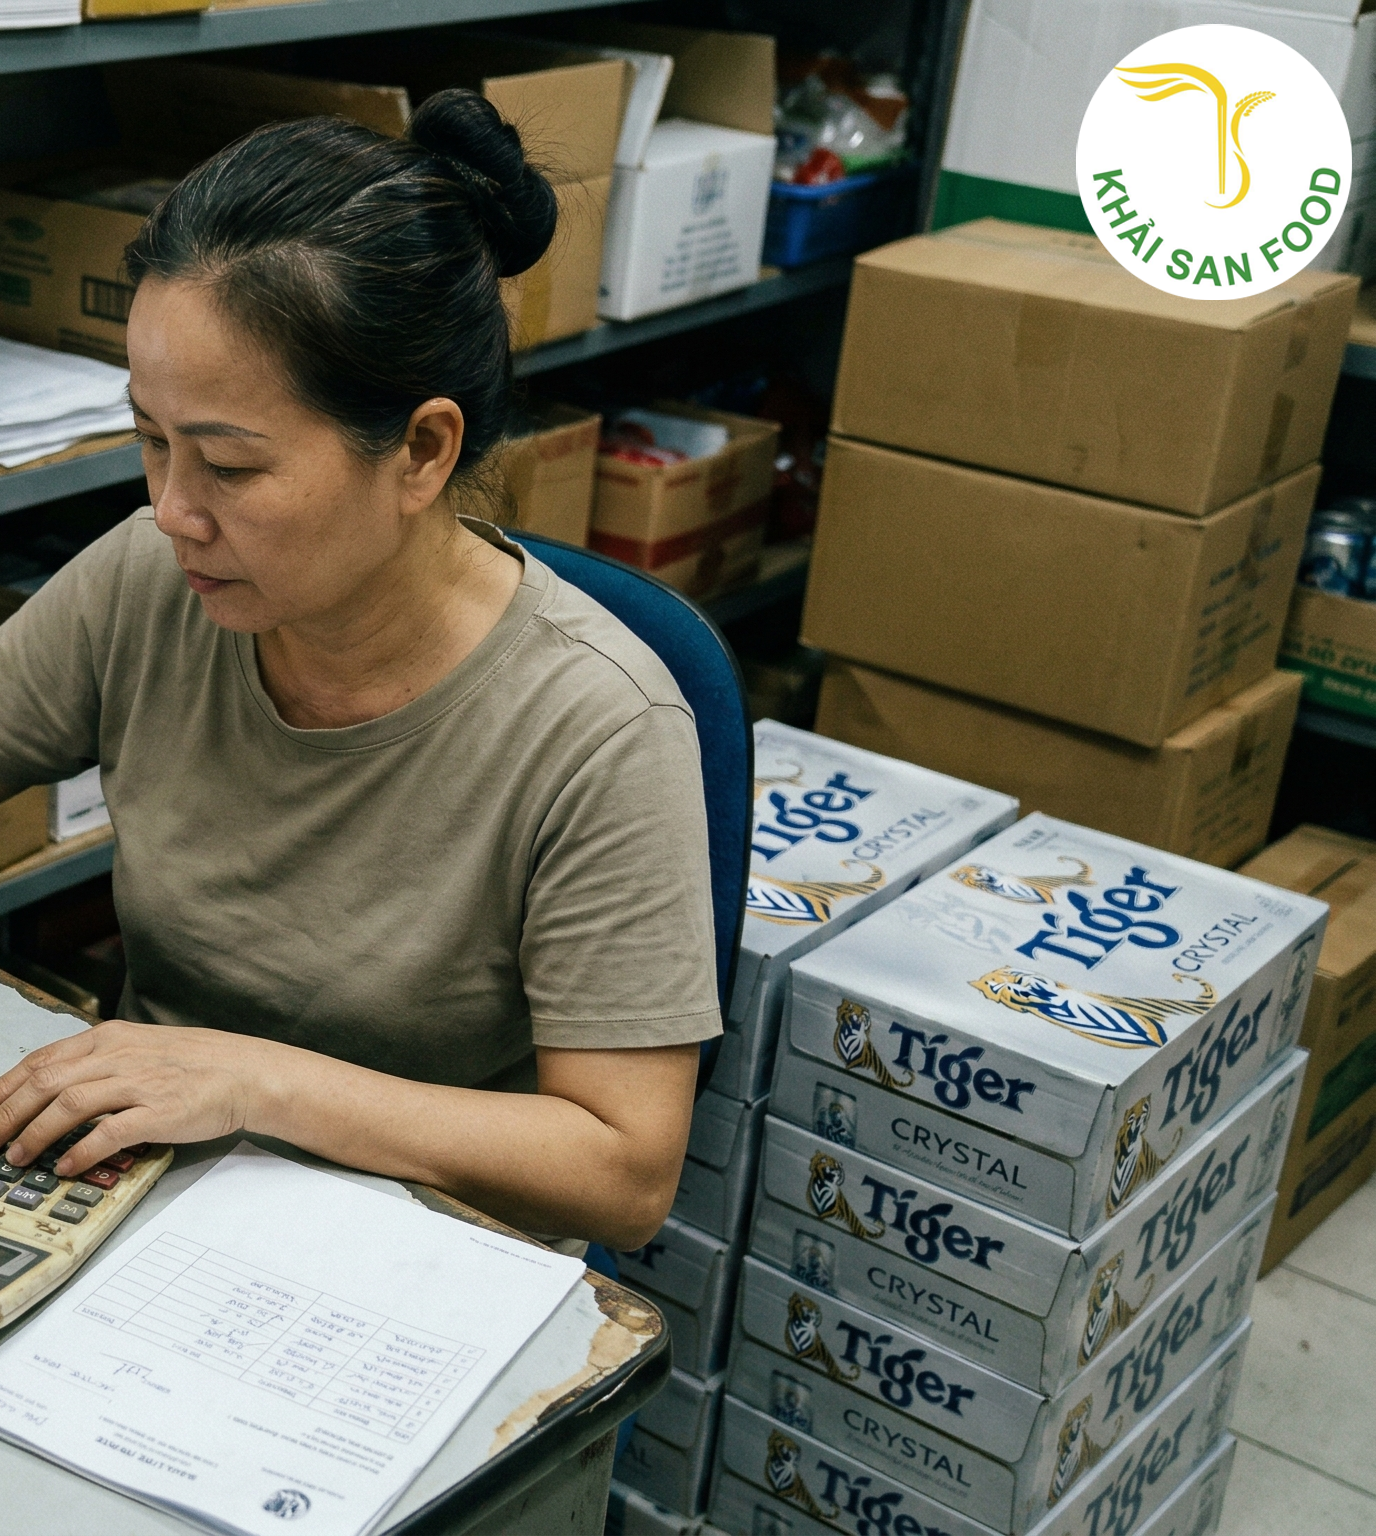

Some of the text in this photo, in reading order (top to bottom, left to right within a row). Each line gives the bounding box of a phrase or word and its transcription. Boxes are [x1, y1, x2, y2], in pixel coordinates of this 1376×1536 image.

[751, 771, 876, 863] iger
[853, 807, 946, 861] CRYSTAL
[1014, 865, 1182, 971] Tiger
[1172, 912, 1258, 973] CRYSTAL
[888, 1021, 1037, 1115] Tiger
[1158, 988, 1273, 1132] Tiger
[890, 1117, 1028, 1190] CRYSTAL
[860, 1174, 1006, 1272] Tiger
[1134, 1134, 1251, 1281] Tiger
[866, 1266, 1000, 1343] CRYSTAL
[1102, 1276, 1218, 1423] Tiger
[836, 1320, 976, 1417] Tiger
[842, 1408, 972, 1488] CRYSTAL
[815, 1459, 952, 1536] Tige
